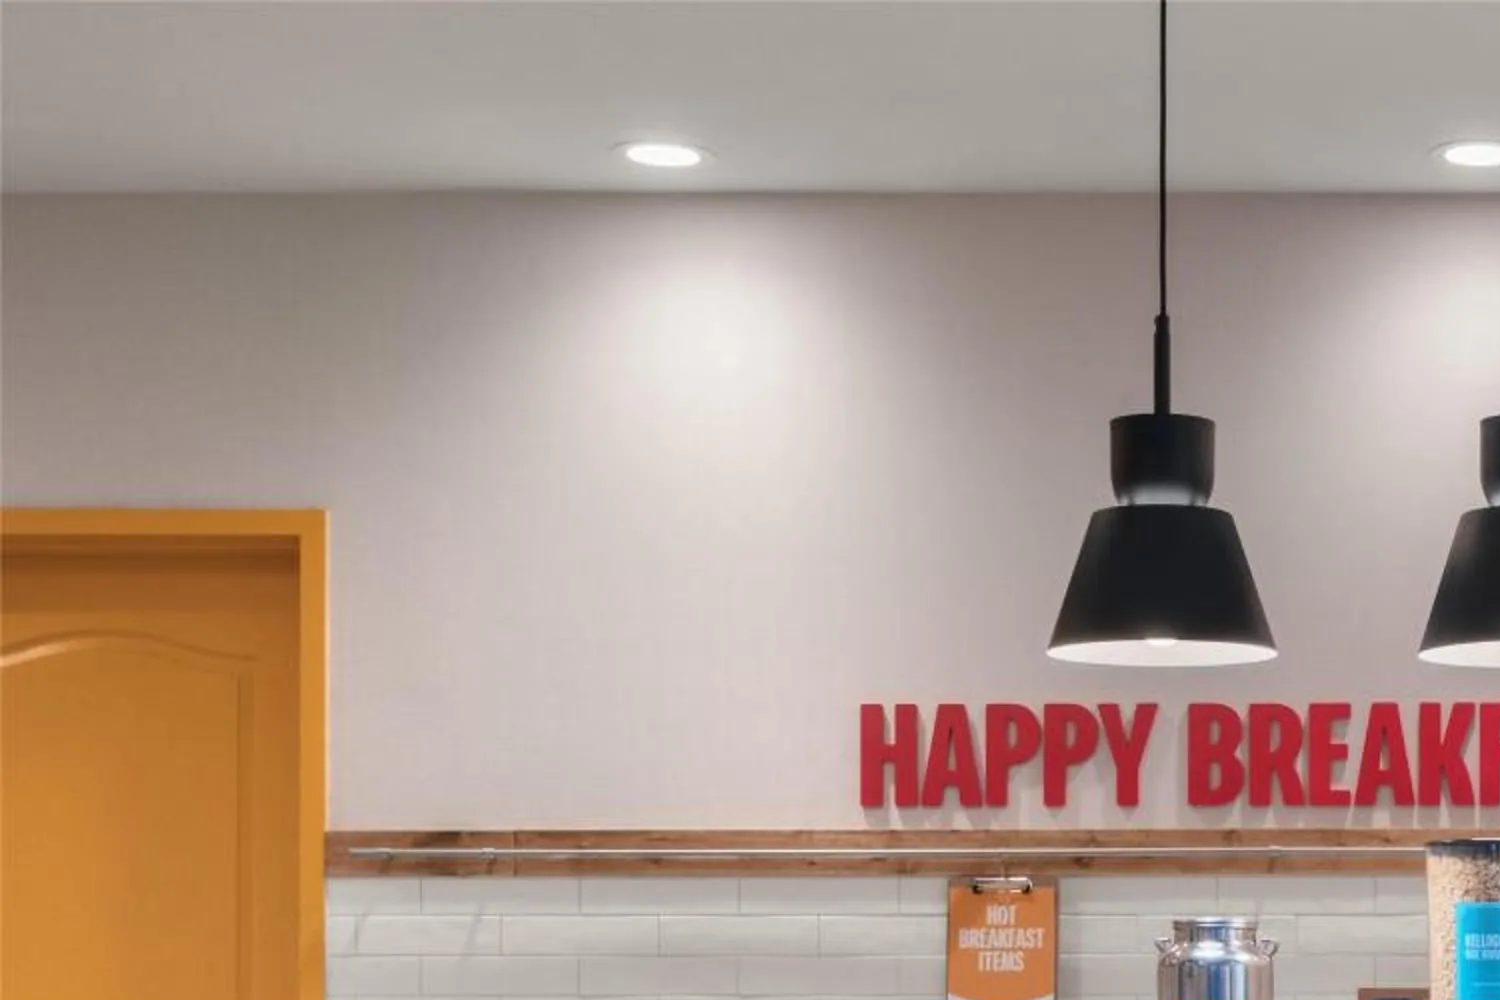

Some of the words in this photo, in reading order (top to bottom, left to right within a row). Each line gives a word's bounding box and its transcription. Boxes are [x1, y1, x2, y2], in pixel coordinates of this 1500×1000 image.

[861, 703, 1158, 807] HAPPY
[986, 904, 1017, 926] HOT
[958, 928, 1046, 949] BREAKFAST
[978, 951, 1025, 972] ITEMS
